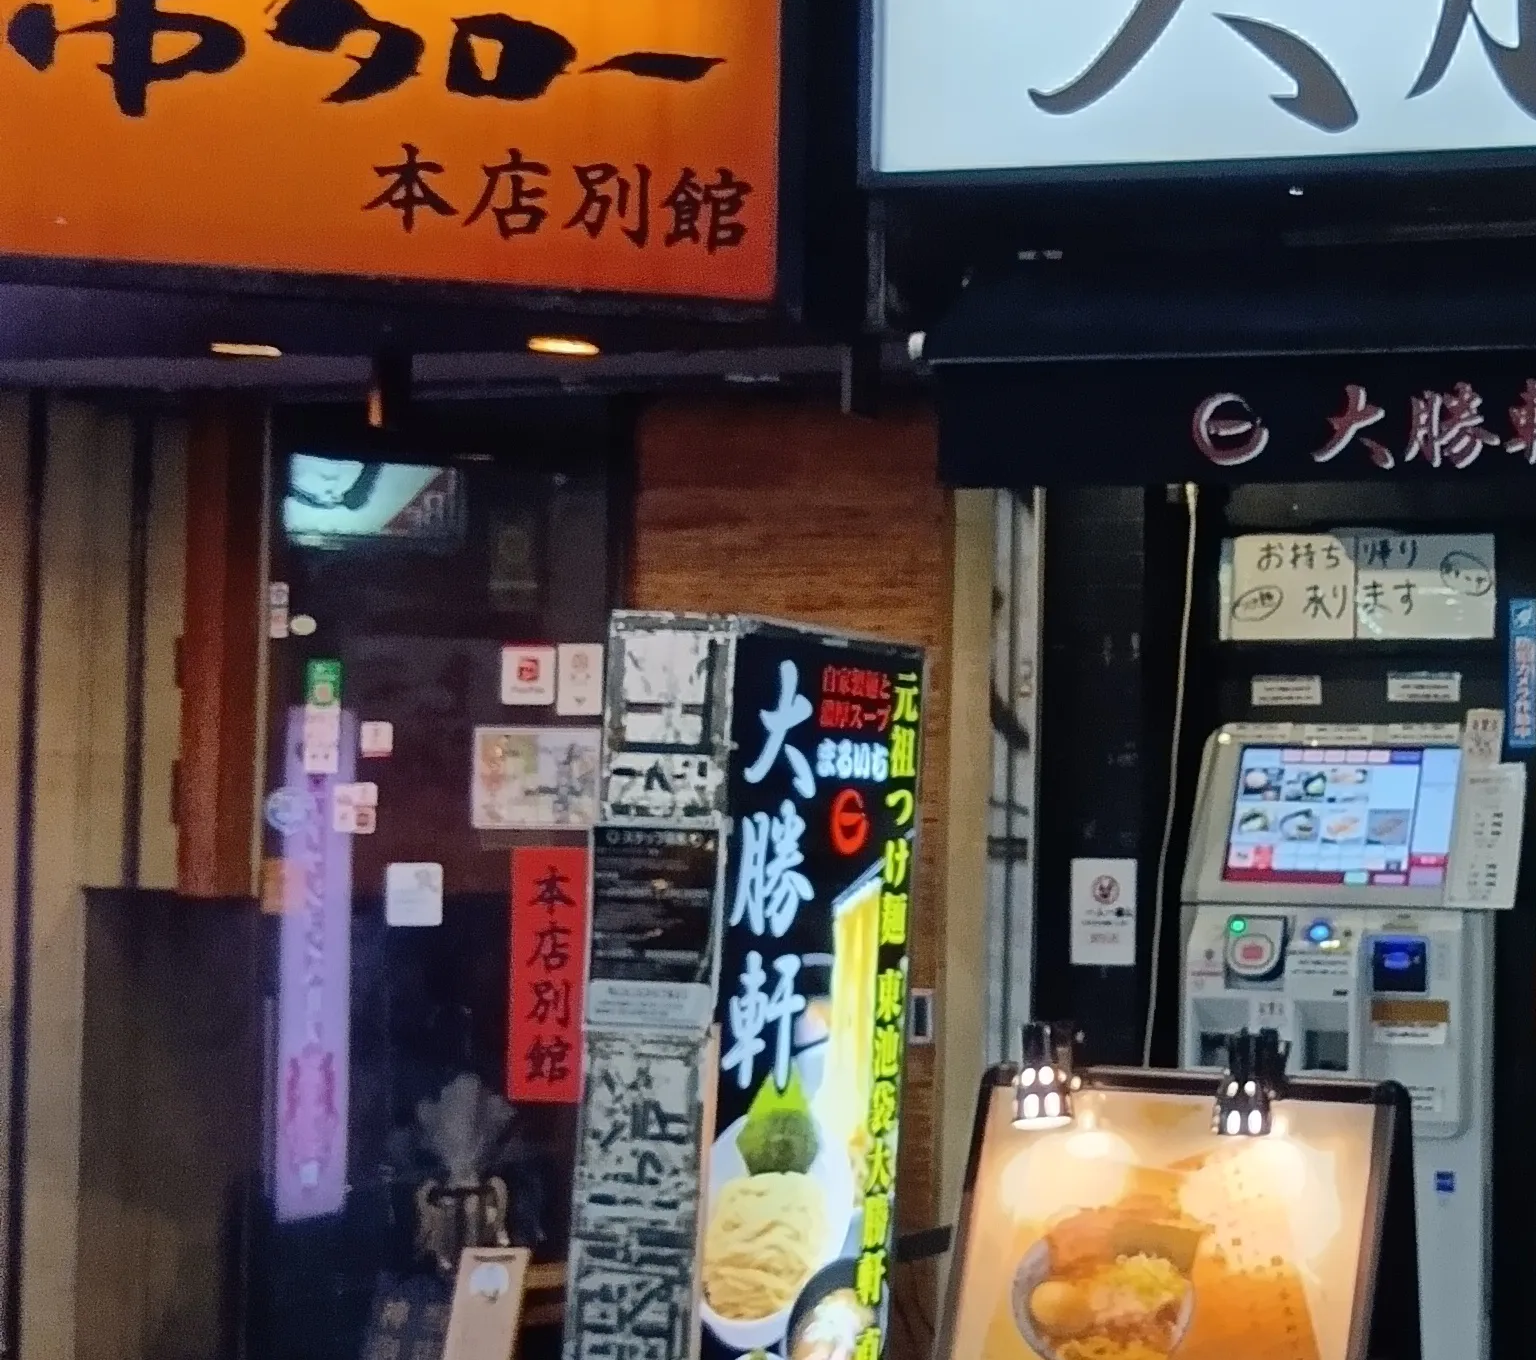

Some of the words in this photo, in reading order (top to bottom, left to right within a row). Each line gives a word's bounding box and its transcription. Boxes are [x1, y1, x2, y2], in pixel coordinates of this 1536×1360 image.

[362, 143, 755, 255] 本店別館
[1303, 579, 1417, 620] 承ります
[816, 738, 889, 782] まるいち
[721, 659, 816, 1090] 大勝軒
[526, 864, 576, 1086] 本店別館
